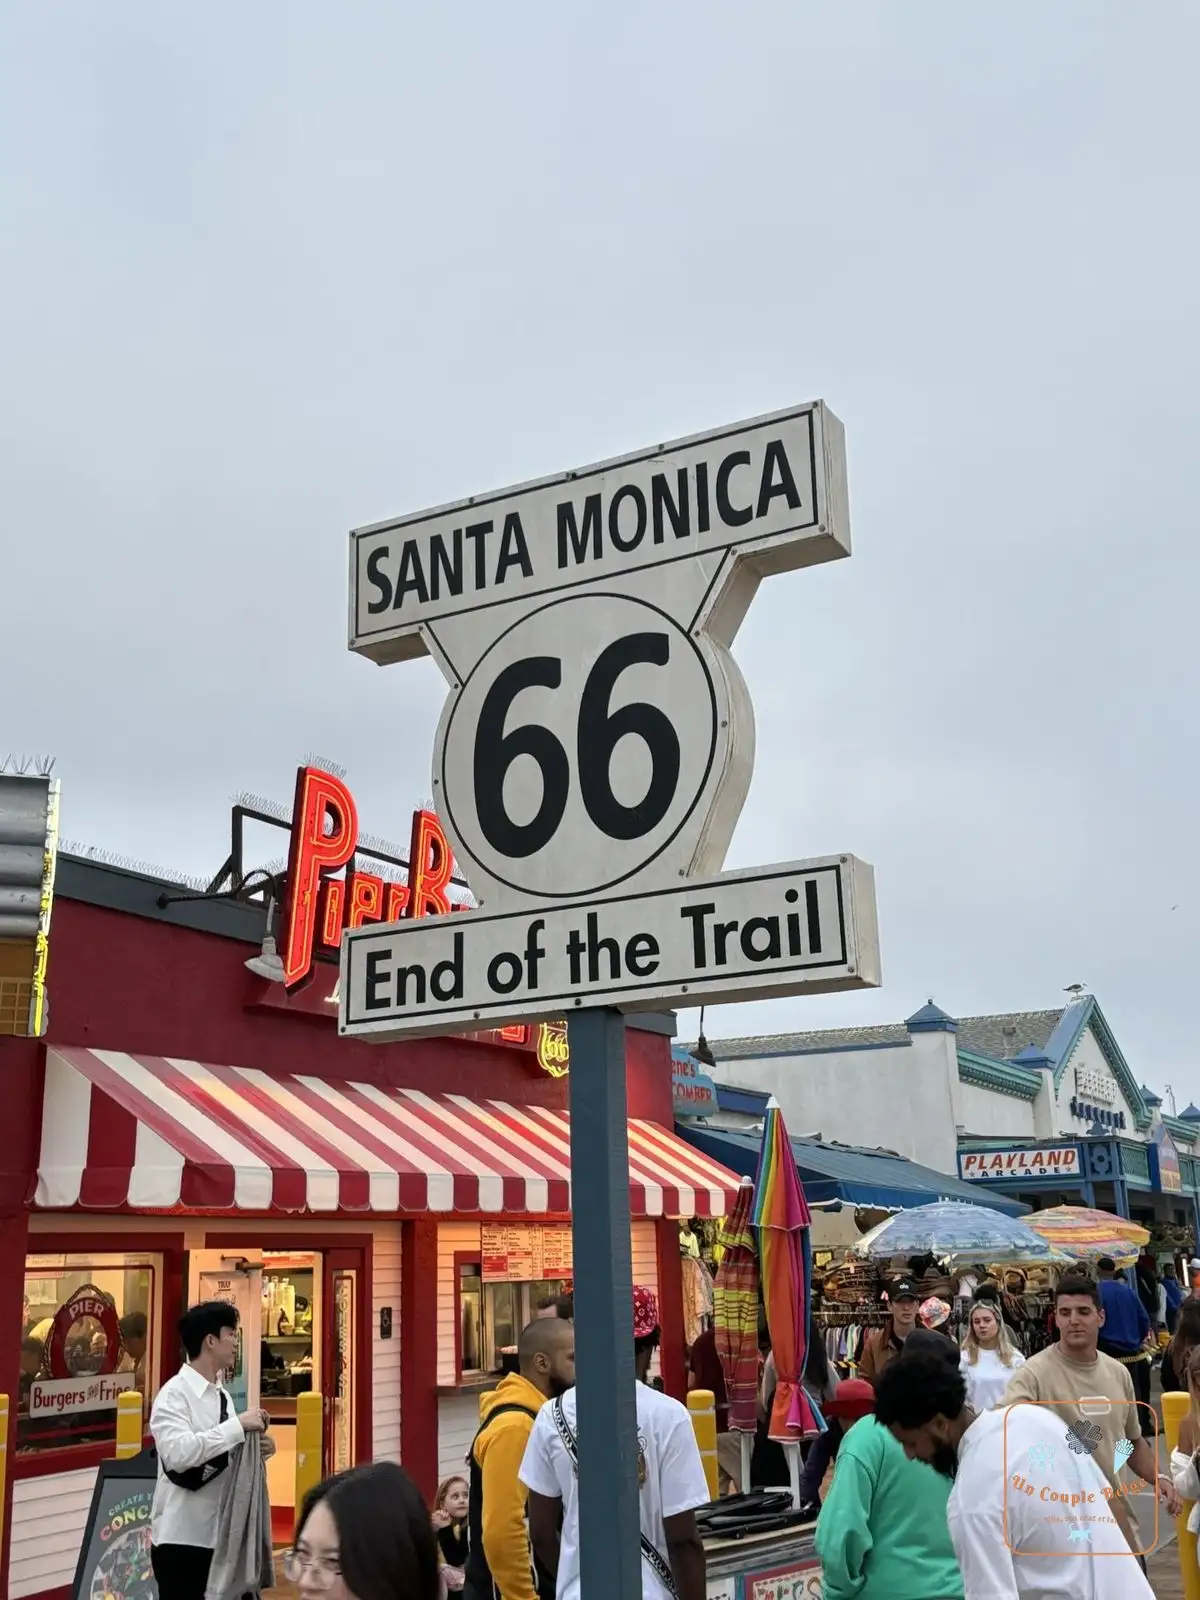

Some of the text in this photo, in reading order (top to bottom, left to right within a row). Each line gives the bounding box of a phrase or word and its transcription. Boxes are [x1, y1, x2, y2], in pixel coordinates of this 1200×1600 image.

[366, 439, 801, 615] SANTA MONICA
[473, 632, 680, 858] 66
[365, 880, 823, 1010] End of the Trail
[545, 1032, 569, 1062] 66
[964, 1150, 1076, 1170] PLAYLAND
[981, 1166, 1061, 1177] ARCADE
[69, 1300, 104, 1319] PIER
[33, 1386, 85, 1412] Burgers
[109, 1494, 145, 1516] CREATE
[101, 1504, 152, 1541] CONC
